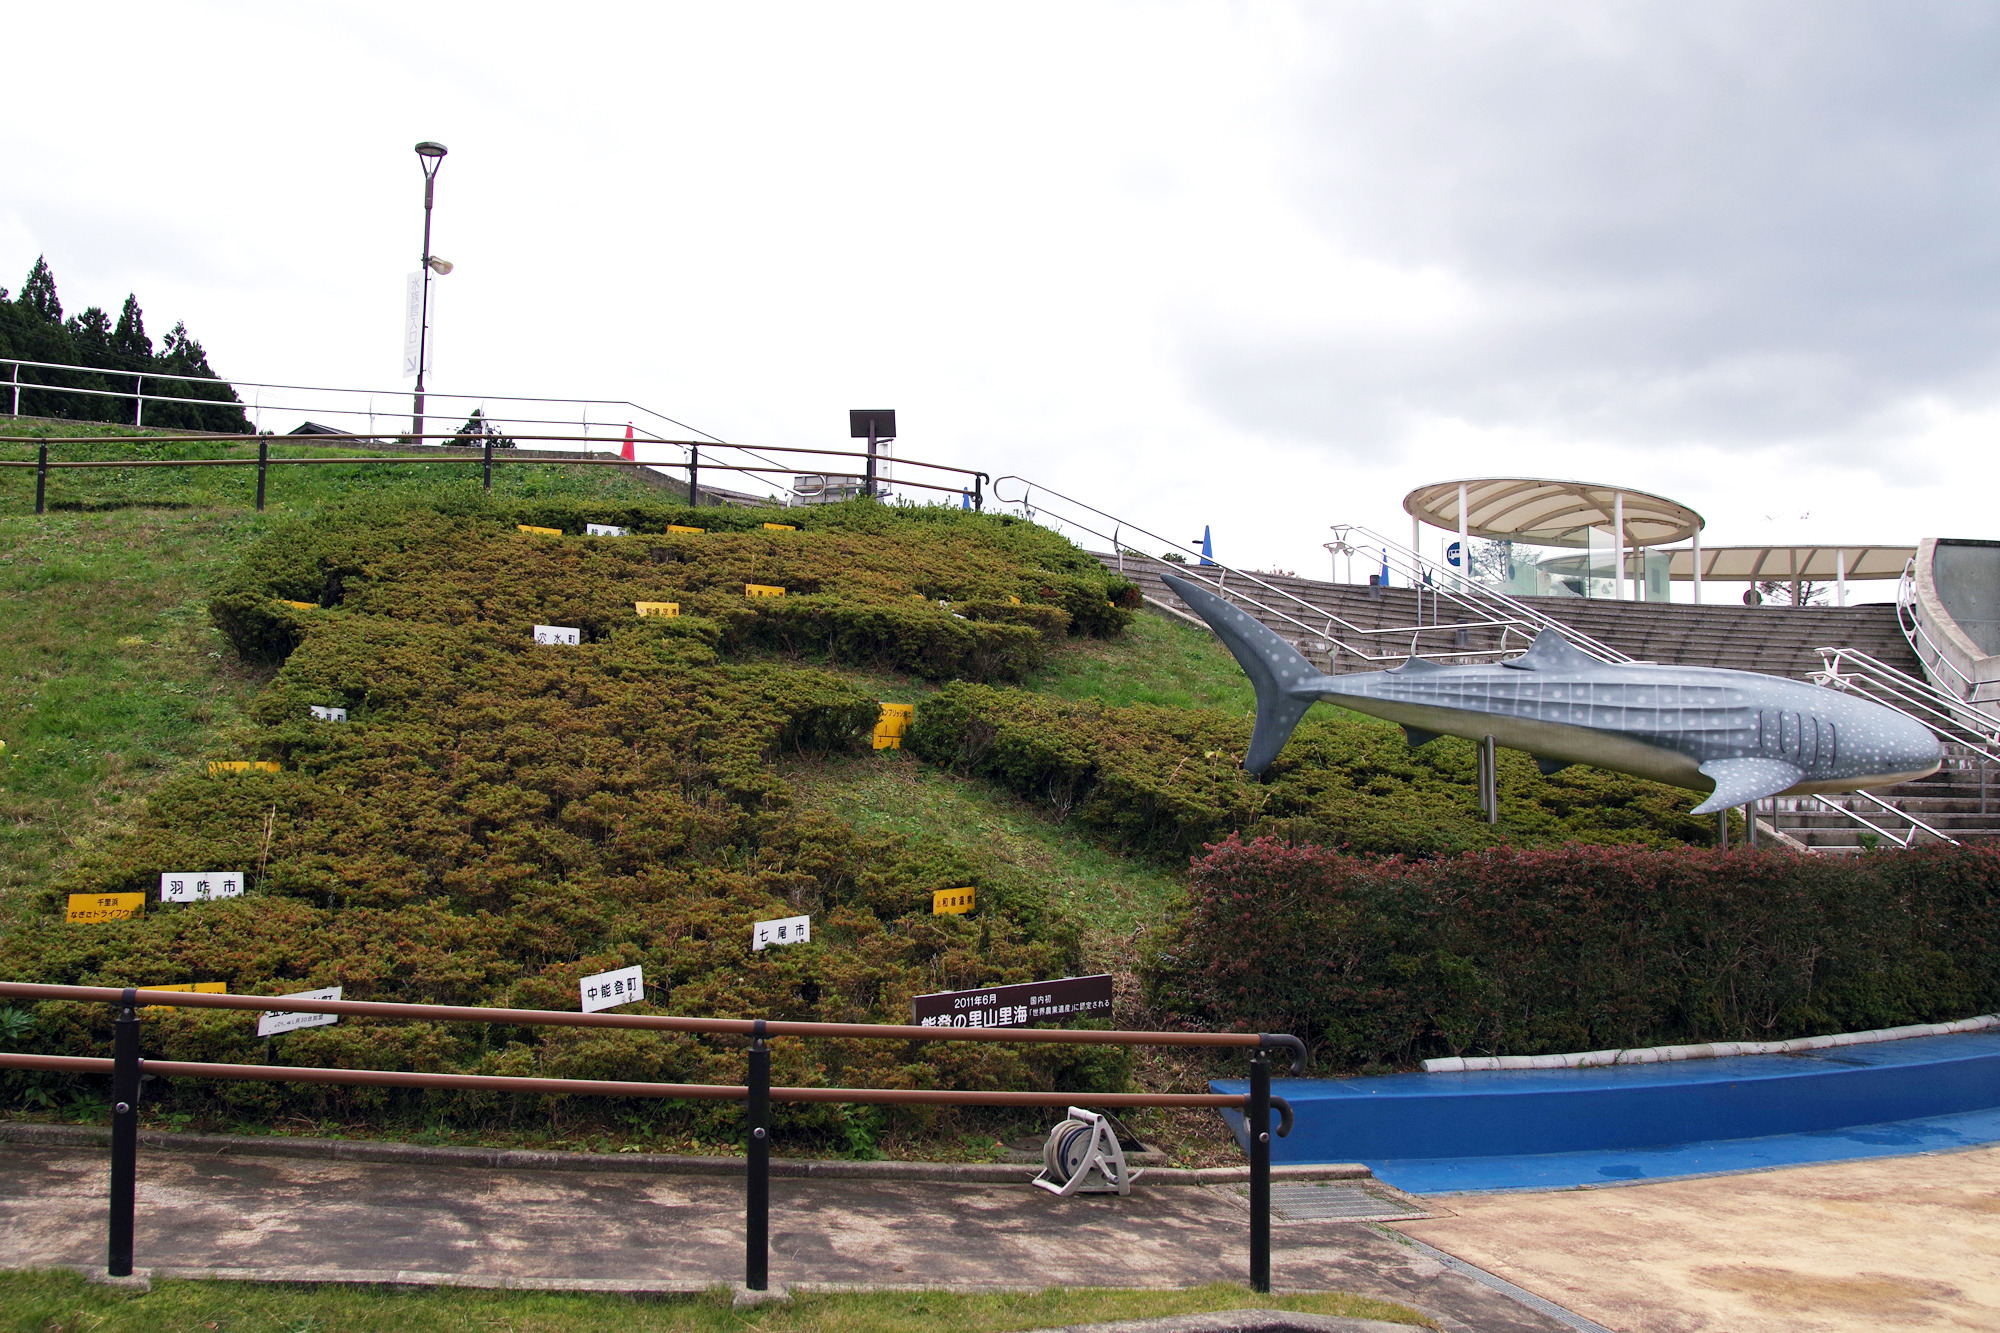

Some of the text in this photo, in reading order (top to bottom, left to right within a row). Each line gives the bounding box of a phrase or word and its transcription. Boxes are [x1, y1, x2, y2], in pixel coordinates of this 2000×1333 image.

[539, 632, 576, 644] 穴水町
[170, 880, 236, 894] 羽咋市
[97, 898, 119, 907] 千里浜
[759, 923, 805, 943] 七尾市
[587, 976, 637, 1001] 中能登町
[954, 993, 997, 1009] 2011年6月
[1029, 994, 1052, 1005] 国内初
